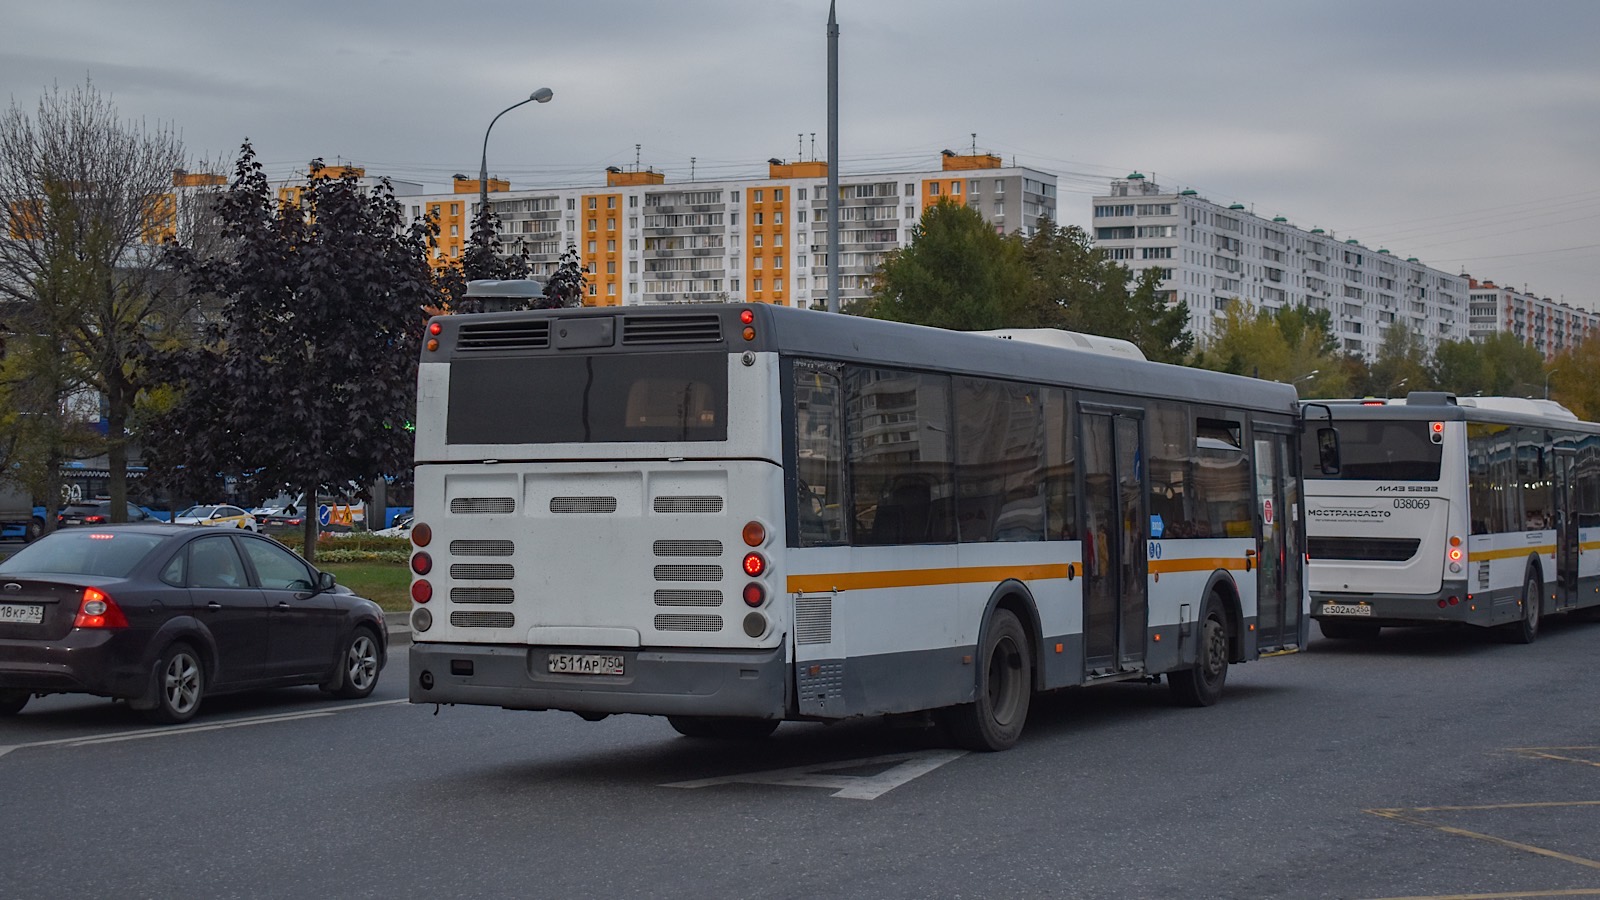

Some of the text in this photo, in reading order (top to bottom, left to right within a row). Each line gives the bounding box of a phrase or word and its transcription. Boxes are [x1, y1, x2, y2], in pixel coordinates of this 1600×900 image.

[1393, 499, 1430, 509] 038069
[1308, 509, 1391, 517] МОСТРАНСАВТО
[29, 606, 40, 616] 33
[1325, 606, 1355, 614] С502АО
[552, 656, 621, 671] У511АР 750
